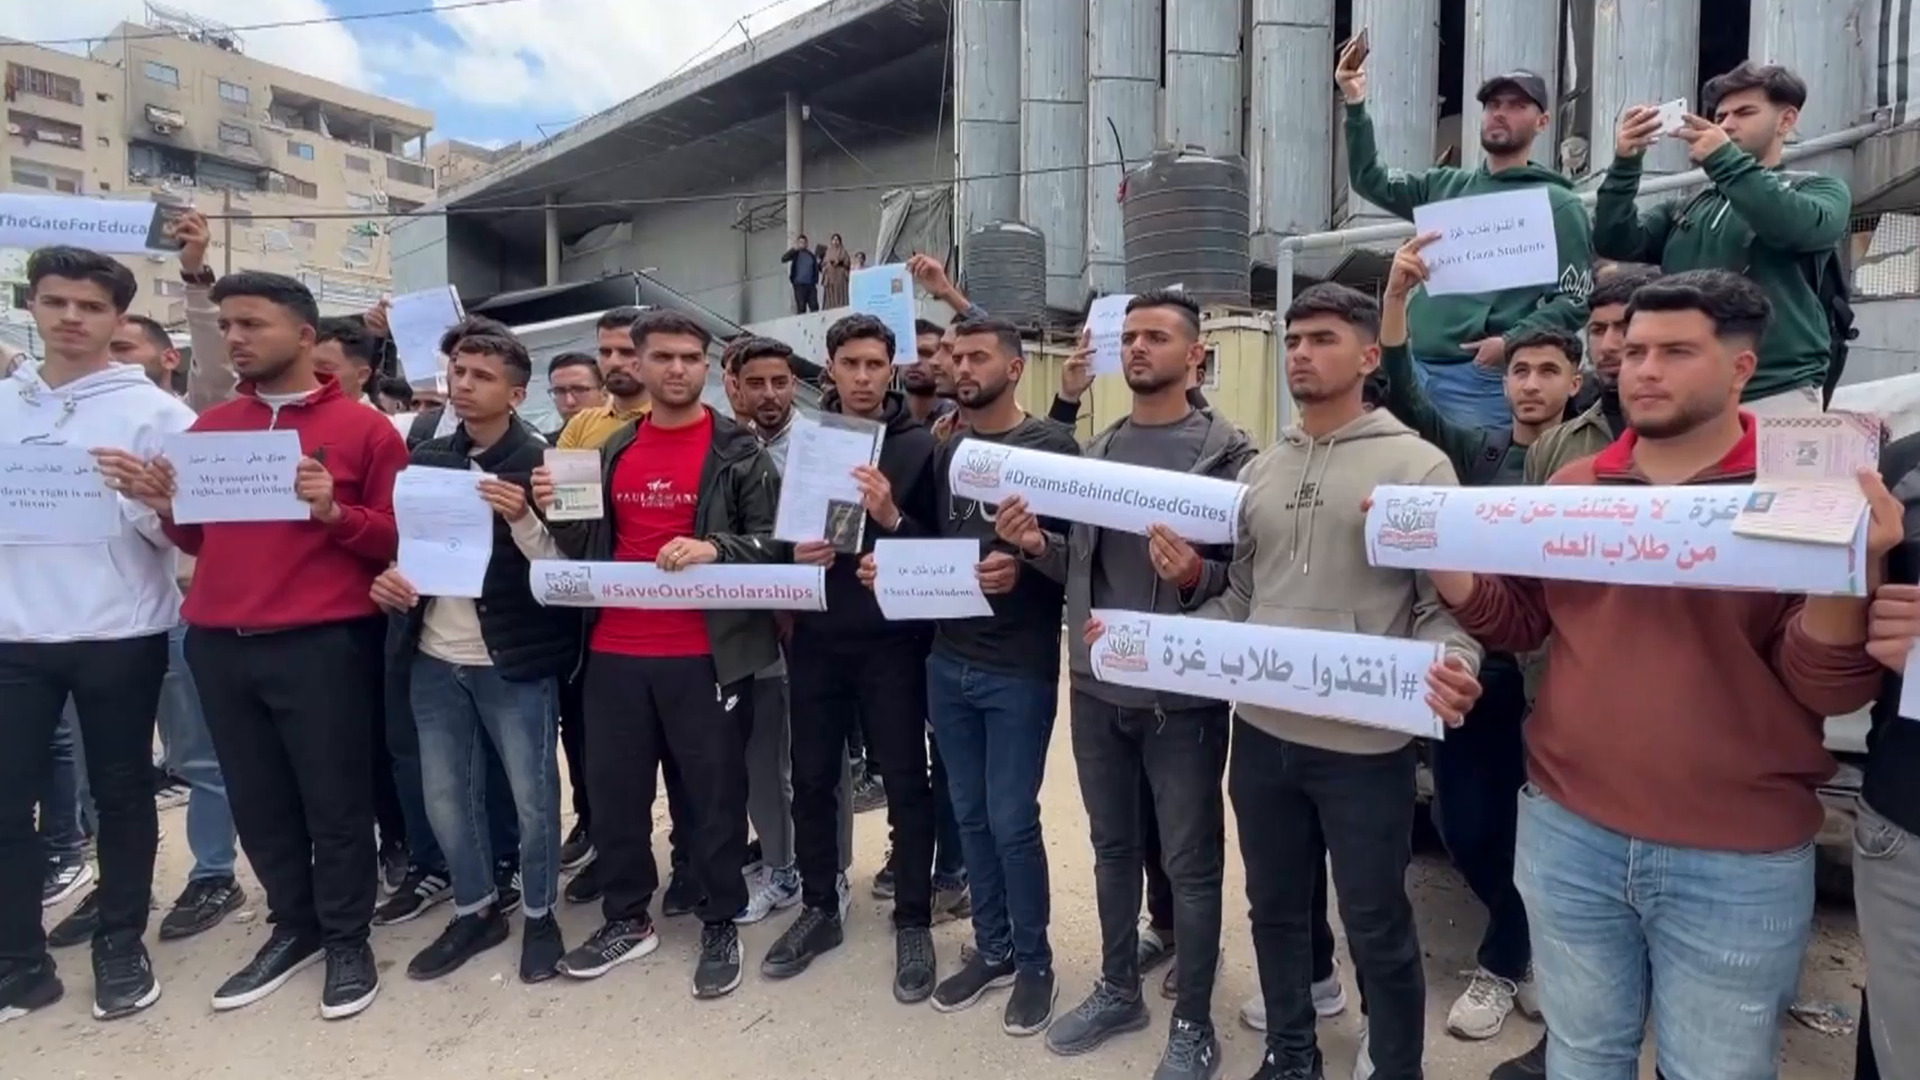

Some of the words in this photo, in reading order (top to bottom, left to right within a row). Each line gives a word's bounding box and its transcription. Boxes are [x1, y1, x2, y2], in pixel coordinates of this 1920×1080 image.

[1438, 255, 1463, 268] Save
[1466, 250, 1494, 261] Gaza
[1497, 241, 1546, 256] Students
[199, 475, 216, 484] My
[219, 472, 260, 485] passport
[84, 489, 102, 499] not
[1004, 470, 1227, 522] #DreamsBehindClosedGates
[1475, 497, 1517, 525] غيره
[1520, 499, 1556, 525] عن
[1562, 497, 1639, 526] يختلف
[1543, 532, 1596, 563] العلم
[1601, 532, 1670, 566] طلاب
[1676, 539, 1716, 570] من
[602, 583, 813, 601] #SaveOurScholarships
[934, 586, 975, 598] Students
[1162, 634, 1419, 699] #أنقذوا_طلاب_غزة
